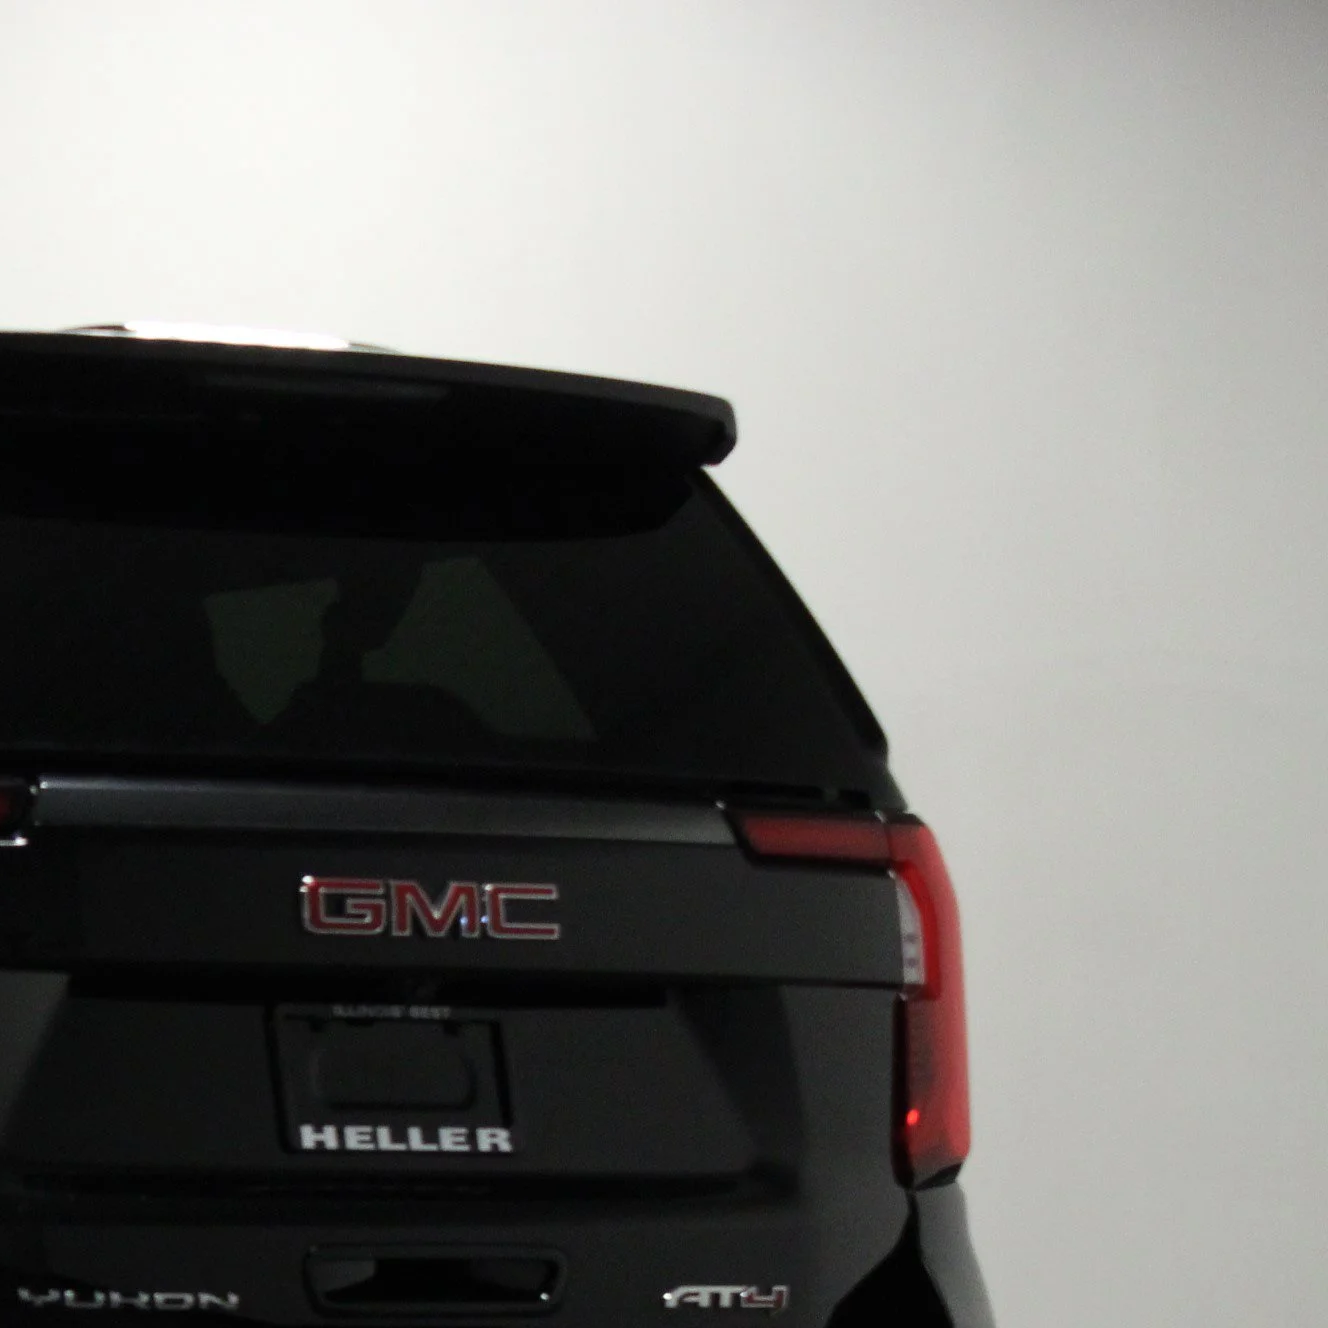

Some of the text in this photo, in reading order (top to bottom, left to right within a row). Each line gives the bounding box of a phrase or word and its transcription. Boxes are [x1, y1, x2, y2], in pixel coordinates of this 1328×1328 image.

[301, 876, 561, 940] GMC
[300, 1124, 513, 1152] HELLER
[17, 1287, 241, 1311] YUKON
[662, 1284, 790, 1314] AT4
